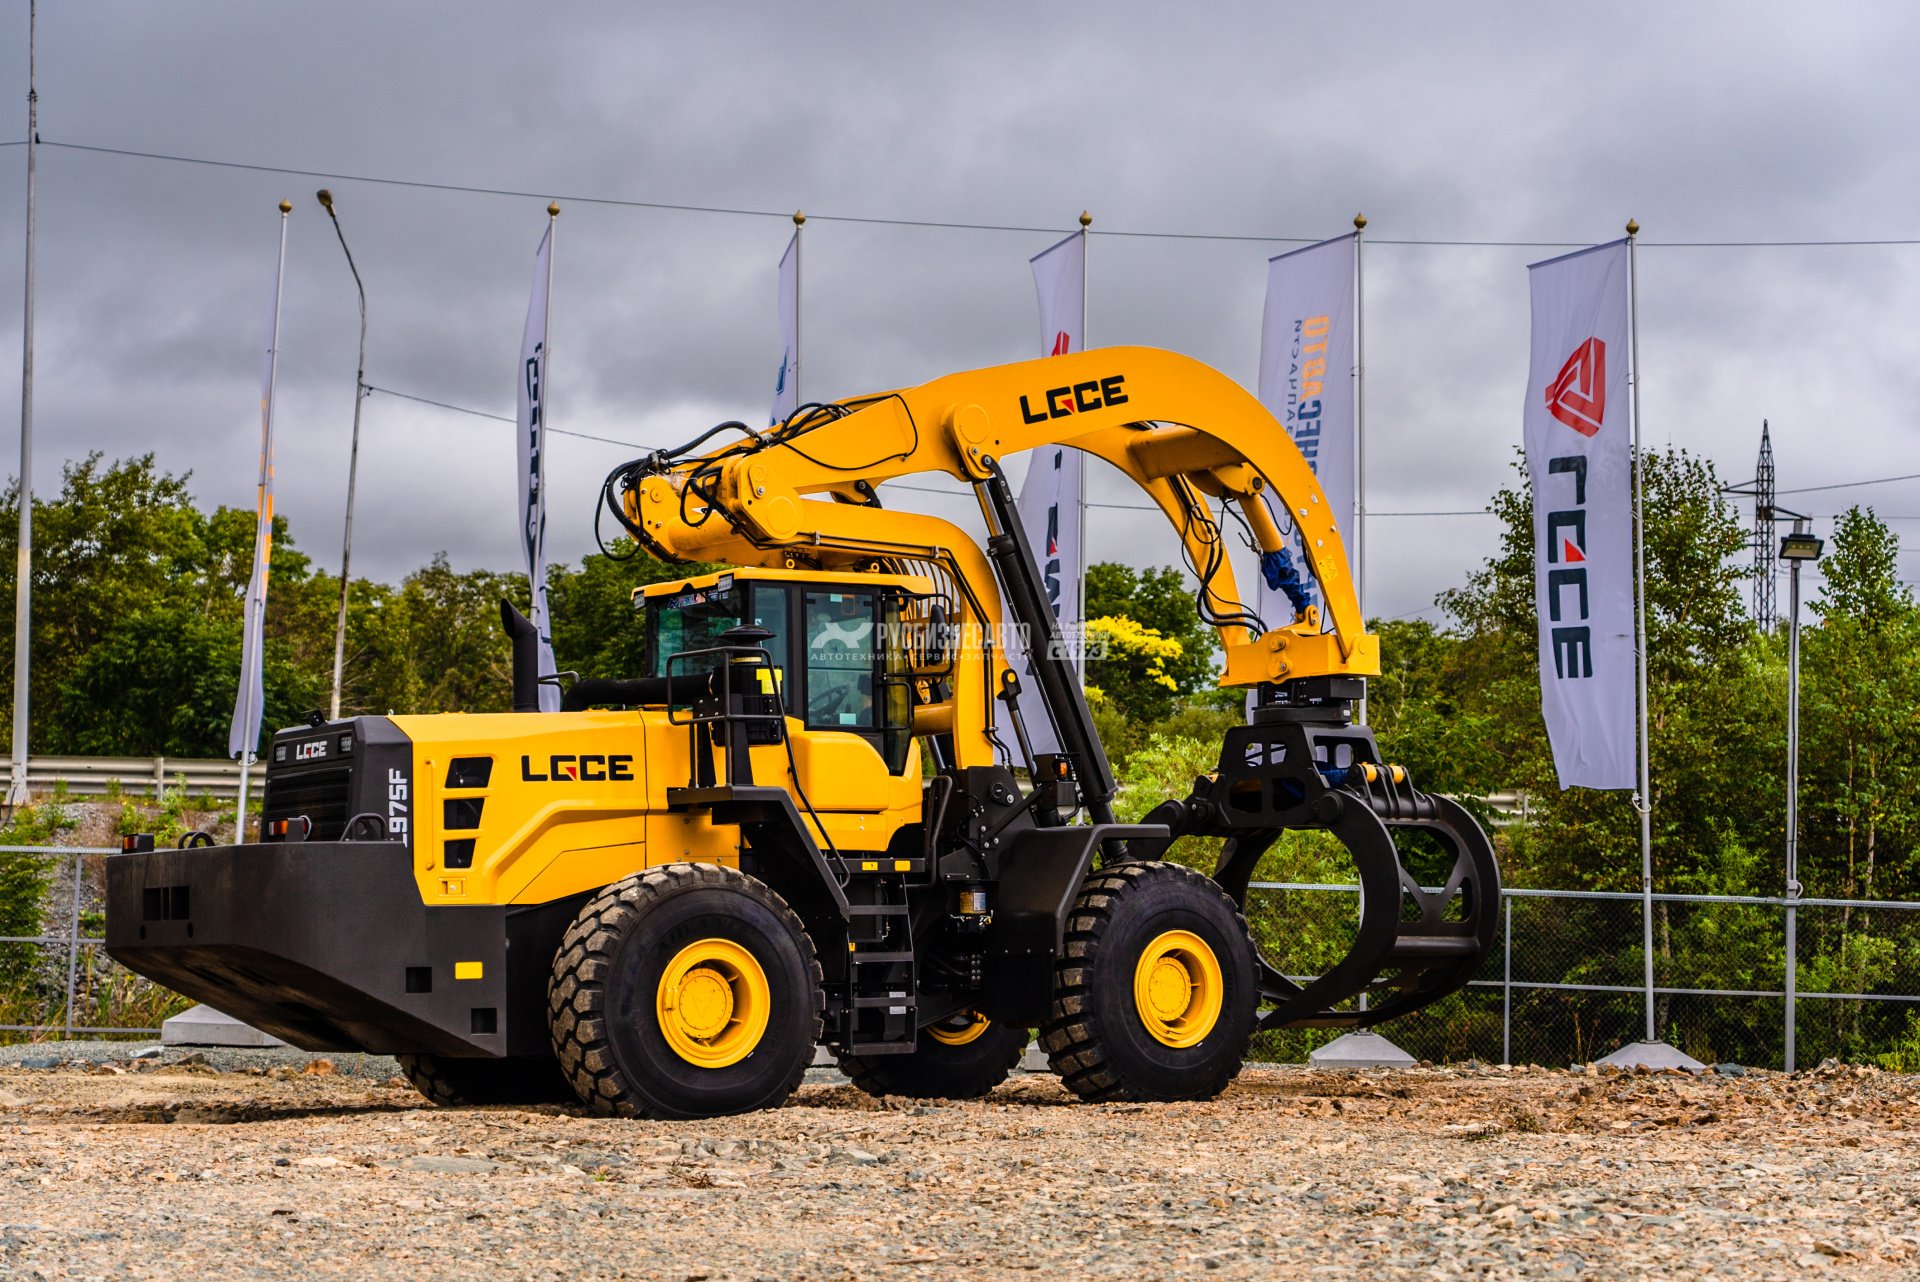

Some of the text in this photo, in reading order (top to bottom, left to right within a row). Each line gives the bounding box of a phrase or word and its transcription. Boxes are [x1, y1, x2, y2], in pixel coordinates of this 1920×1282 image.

[1019, 375, 1129, 425] LGCE
[296, 741, 328, 760] LGCE
[520, 755, 635, 782] LGCE
